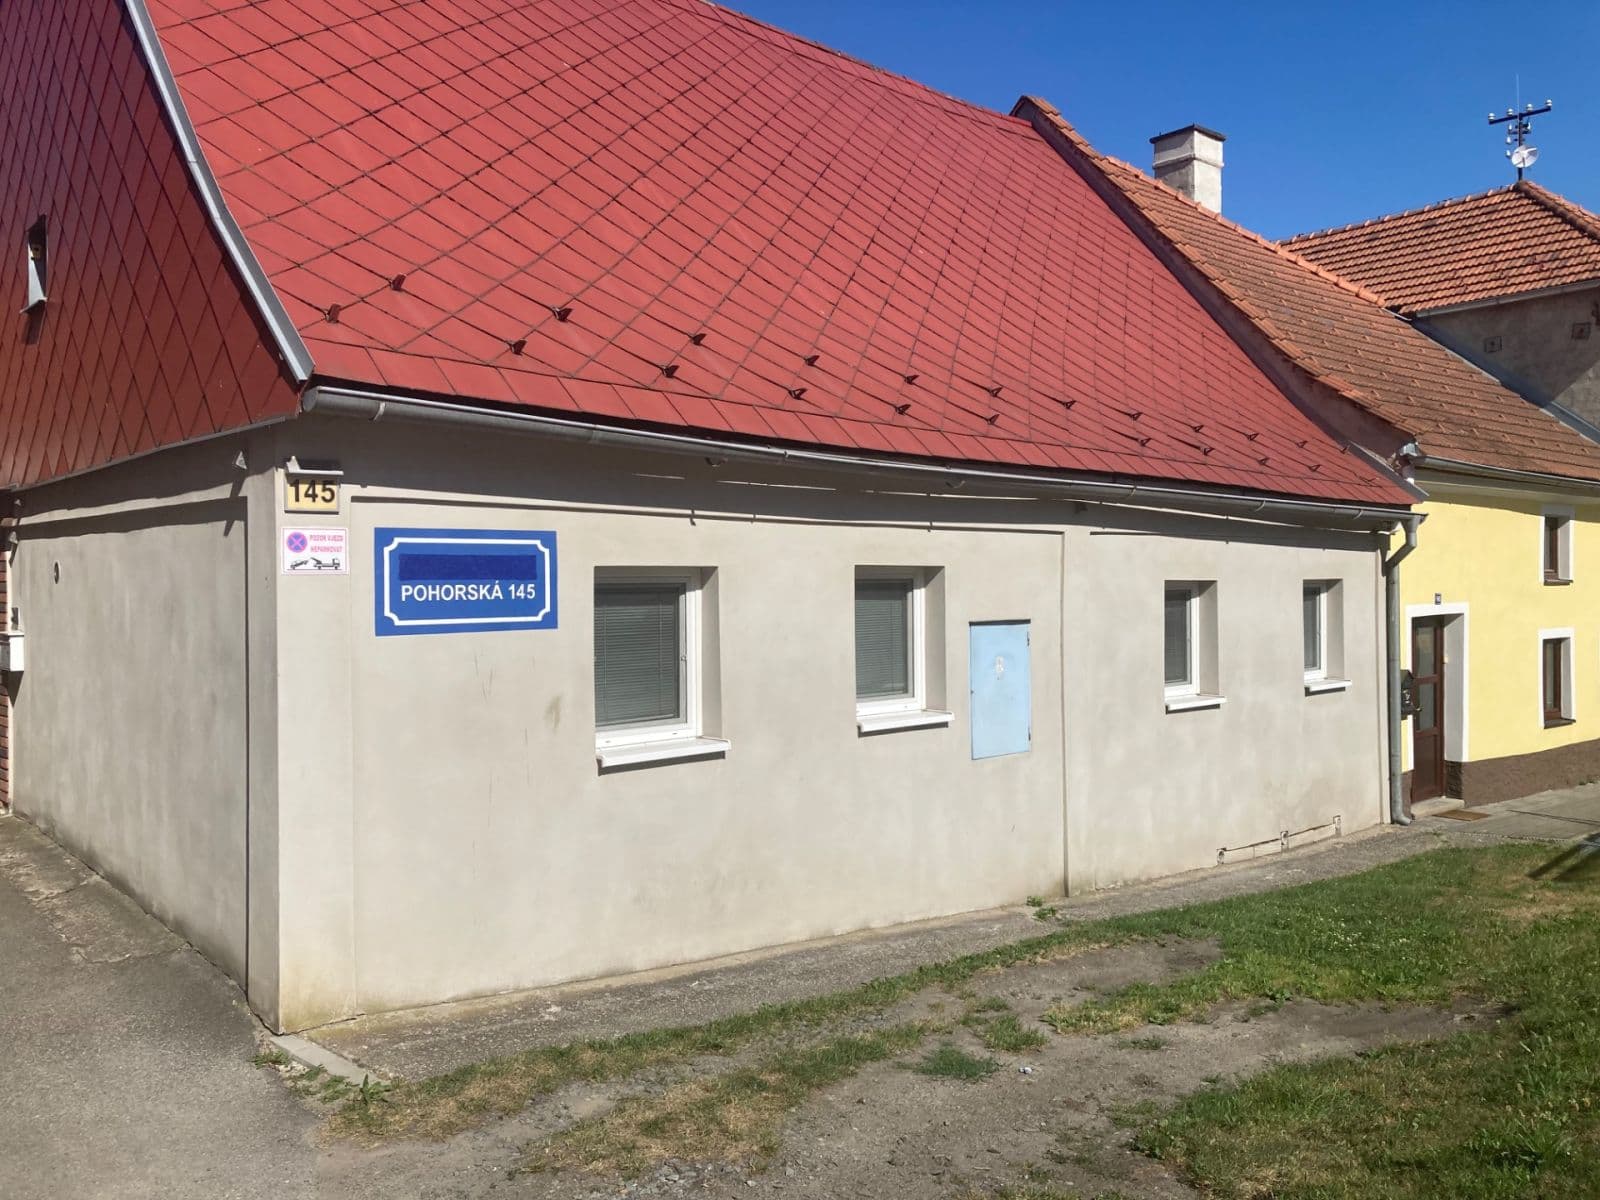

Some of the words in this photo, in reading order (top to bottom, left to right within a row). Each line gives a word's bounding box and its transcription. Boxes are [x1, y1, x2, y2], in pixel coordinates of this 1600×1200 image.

[289, 479, 336, 504] 145
[401, 580, 503, 602] POHORSKÁ
[508, 583, 536, 600] 145
